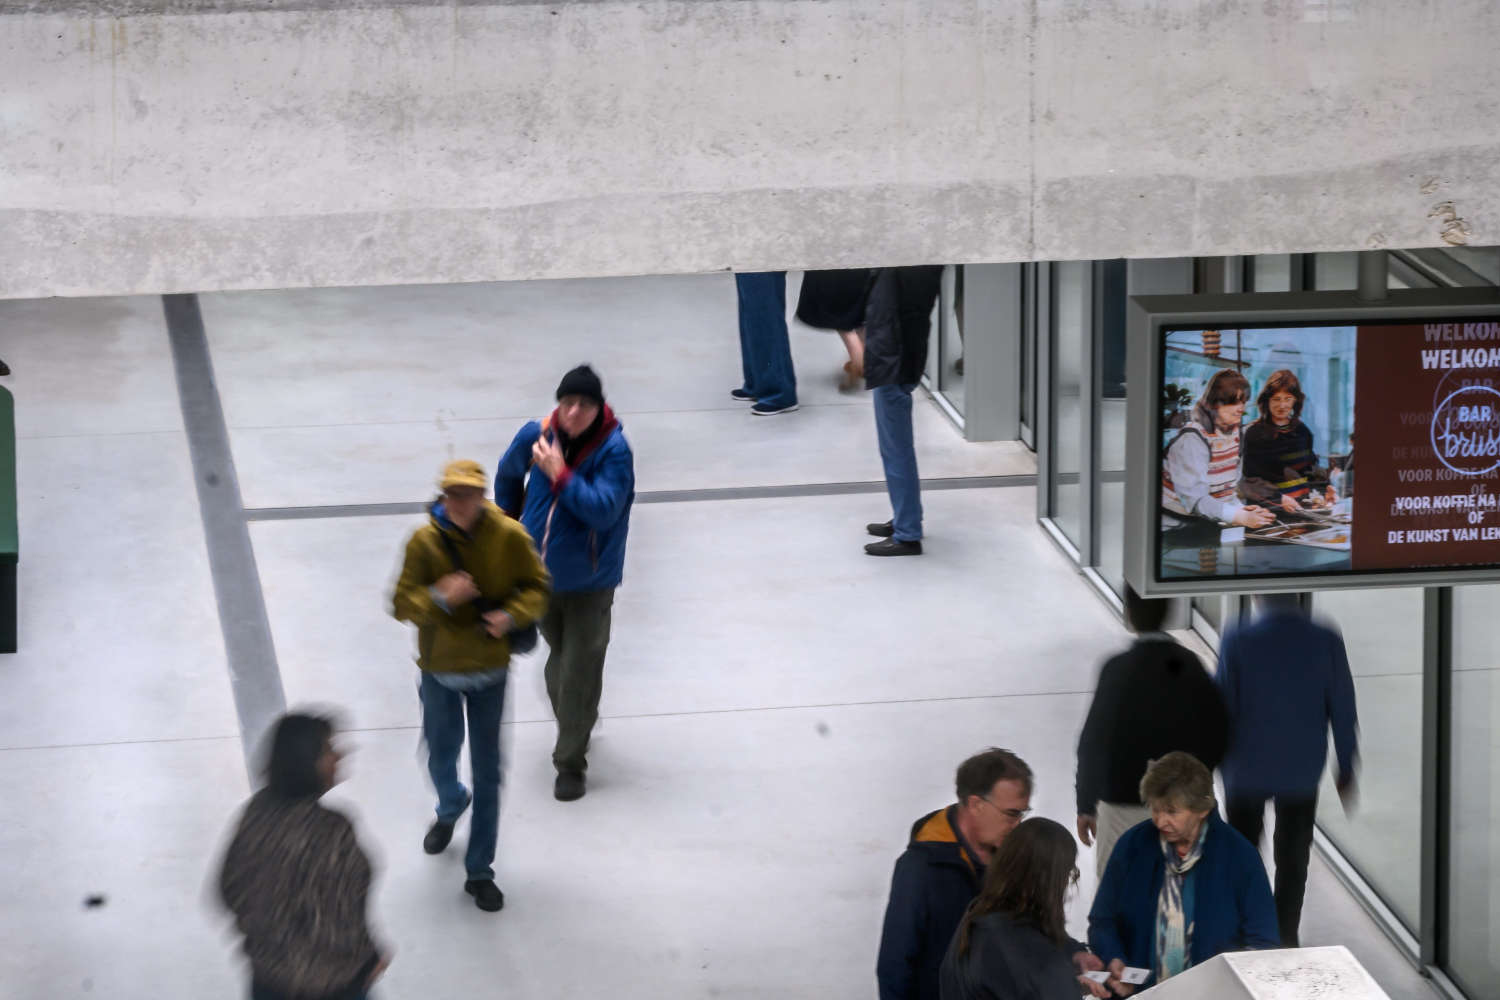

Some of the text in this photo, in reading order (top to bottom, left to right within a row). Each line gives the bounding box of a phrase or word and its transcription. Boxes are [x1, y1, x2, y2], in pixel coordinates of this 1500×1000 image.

[1458, 405, 1492, 423] BAR
[1395, 496, 1431, 510] VOOR
[1433, 494, 1476, 508] KOFFIE
[1478, 493, 1496, 507] NA
[1468, 511, 1485, 524] OF
[1388, 531, 1404, 544] DE
[1406, 529, 1449, 543] KUNST
[1452, 528, 1478, 541] VAN
